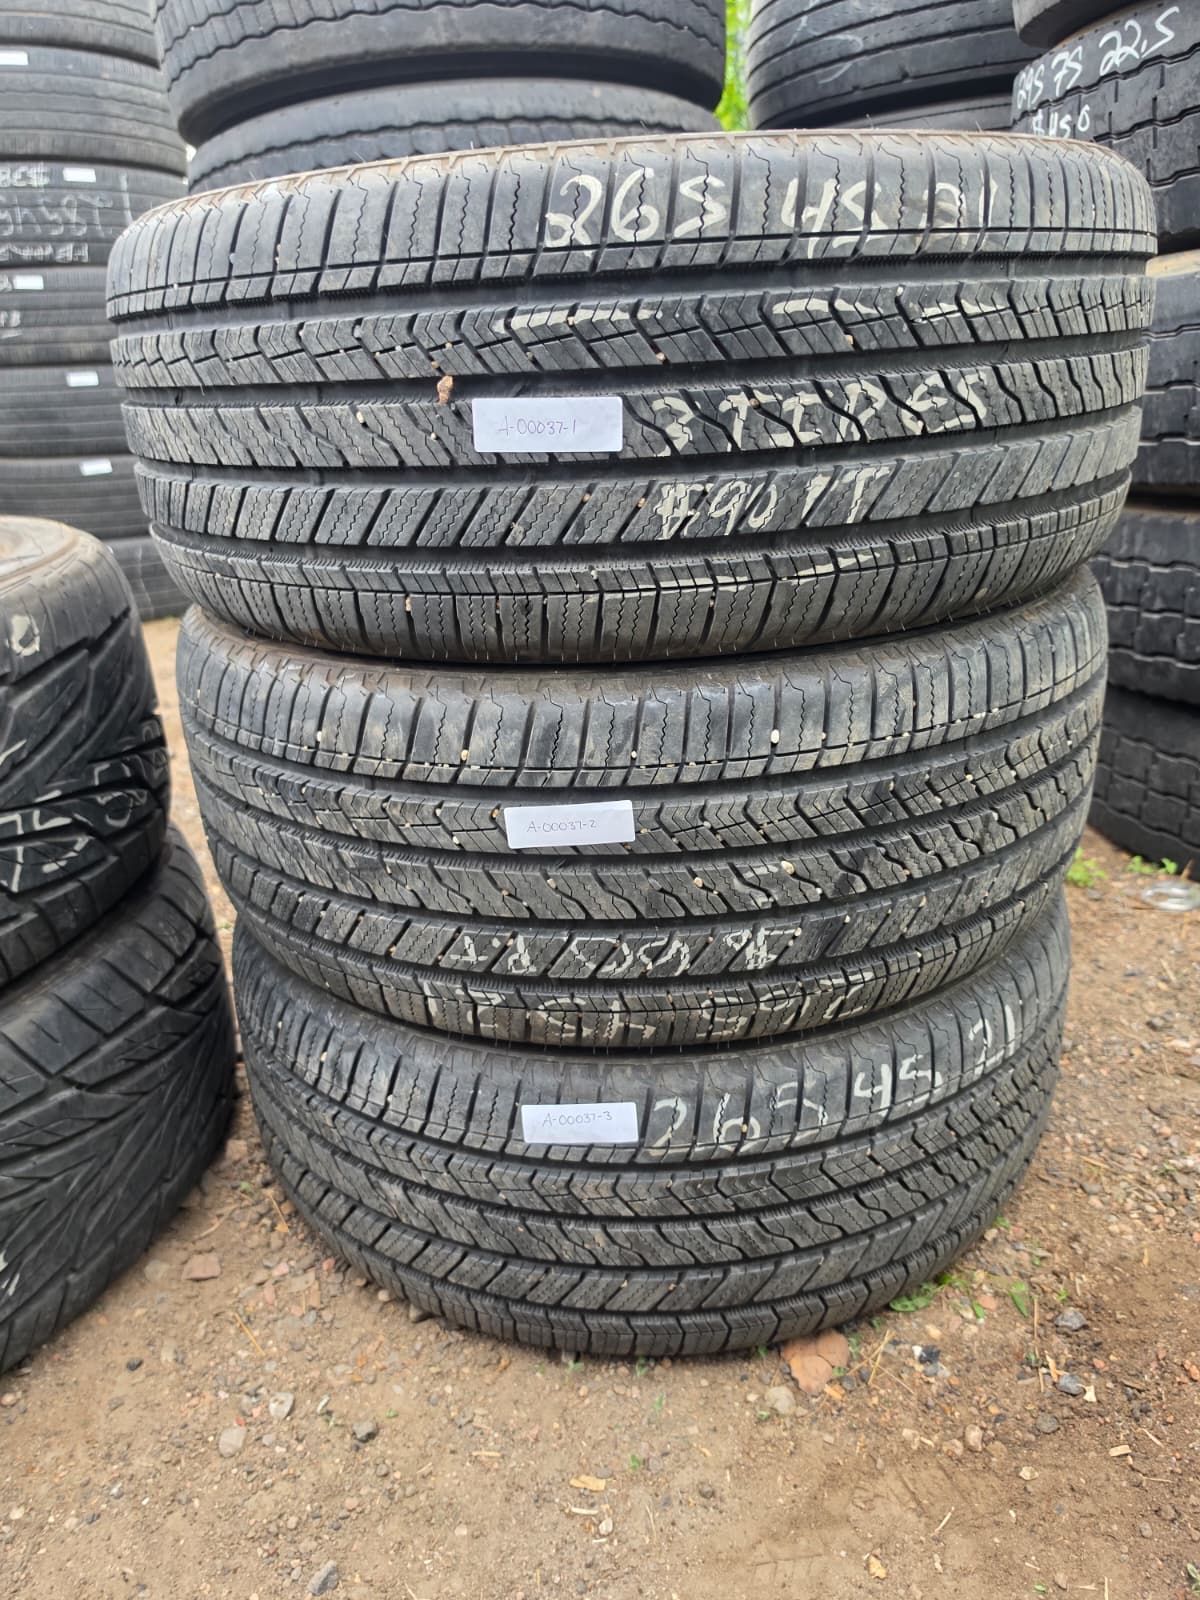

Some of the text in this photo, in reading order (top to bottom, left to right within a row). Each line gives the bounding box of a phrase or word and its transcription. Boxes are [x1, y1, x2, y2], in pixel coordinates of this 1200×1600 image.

[1051, 46, 1083, 97] 75
[1099, 6, 1180, 76] 22.5
[543, 167, 728, 258] 265
[780, 177, 891, 260] 45
[718, 370, 989, 453] TIRES
[526, 818, 599, 834] A-00037-2
[541, 1110, 614, 1128] A-00037-3
[649, 1004, 1016, 1158] 265 45 21
